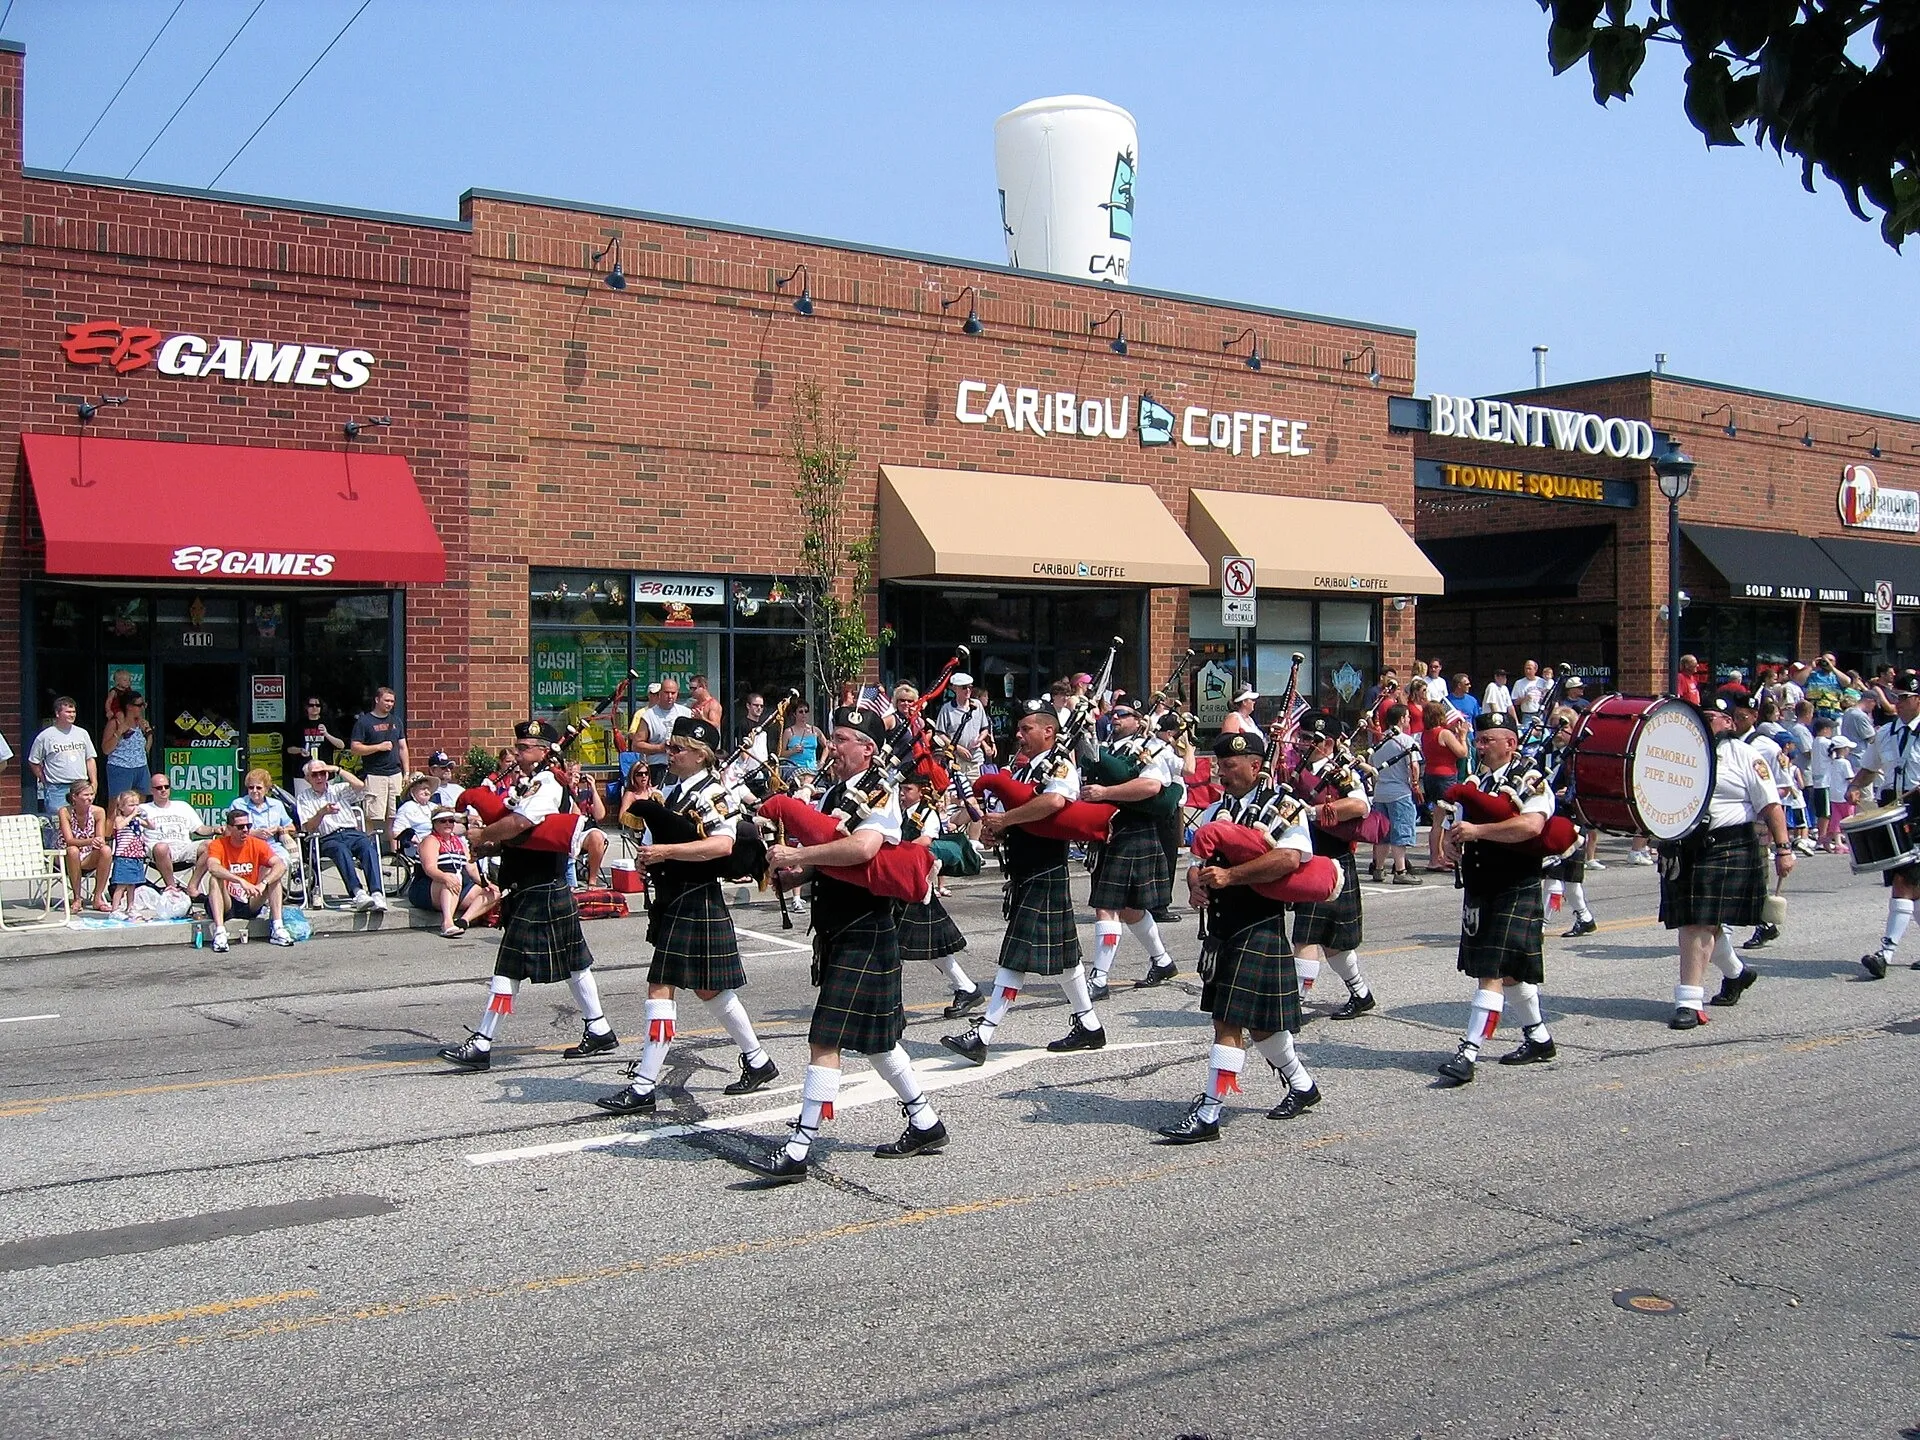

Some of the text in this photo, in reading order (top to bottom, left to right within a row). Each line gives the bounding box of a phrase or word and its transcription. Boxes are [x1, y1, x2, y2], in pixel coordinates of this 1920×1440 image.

[61, 321, 376, 390] EB GAMES
[955, 380, 1310, 458] CARIBOU COFFEE
[1429, 394, 1654, 460] BRENTWOOD
[1442, 464, 1604, 500] TOWNE SQUARE
[171, 546, 336, 577] EB GAMES
[1032, 562, 1126, 578] CARIBOU COFFEE
[639, 581, 715, 598] EB GAMES
[1313, 576, 1389, 590] CARIBOU COFFEE
[1745, 584, 1774, 597] SOUP
[1780, 587, 1811, 600] SALAD
[1819, 589, 1848, 601] PANINI
[1896, 595, 1920, 607] PIZZA
[1239, 603, 1252, 612] USE
[1224, 613, 1254, 623] CROSSWALK
[183, 632, 214, 647] 4110
[537, 652, 576, 669] CASH
[660, 649, 694, 665] CASH
[549, 671, 564, 680] FOR
[254, 683, 282, 694] Open
[538, 681, 576, 695] GAMES
[1645, 711, 1704, 747] PITTSBURGH
[53, 741, 87, 753] Steelers
[190, 739, 232, 748] GAMES
[169, 751, 191, 765] GET
[1645, 745, 1697, 768] MEMORIAL
[170, 765, 233, 790] CASH
[1644, 766, 1694, 789] PIPE BAND
[190, 793, 214, 806] FOR
[1633, 782, 1701, 825] FIREFIGHTERS
[230, 862, 253, 874] race
